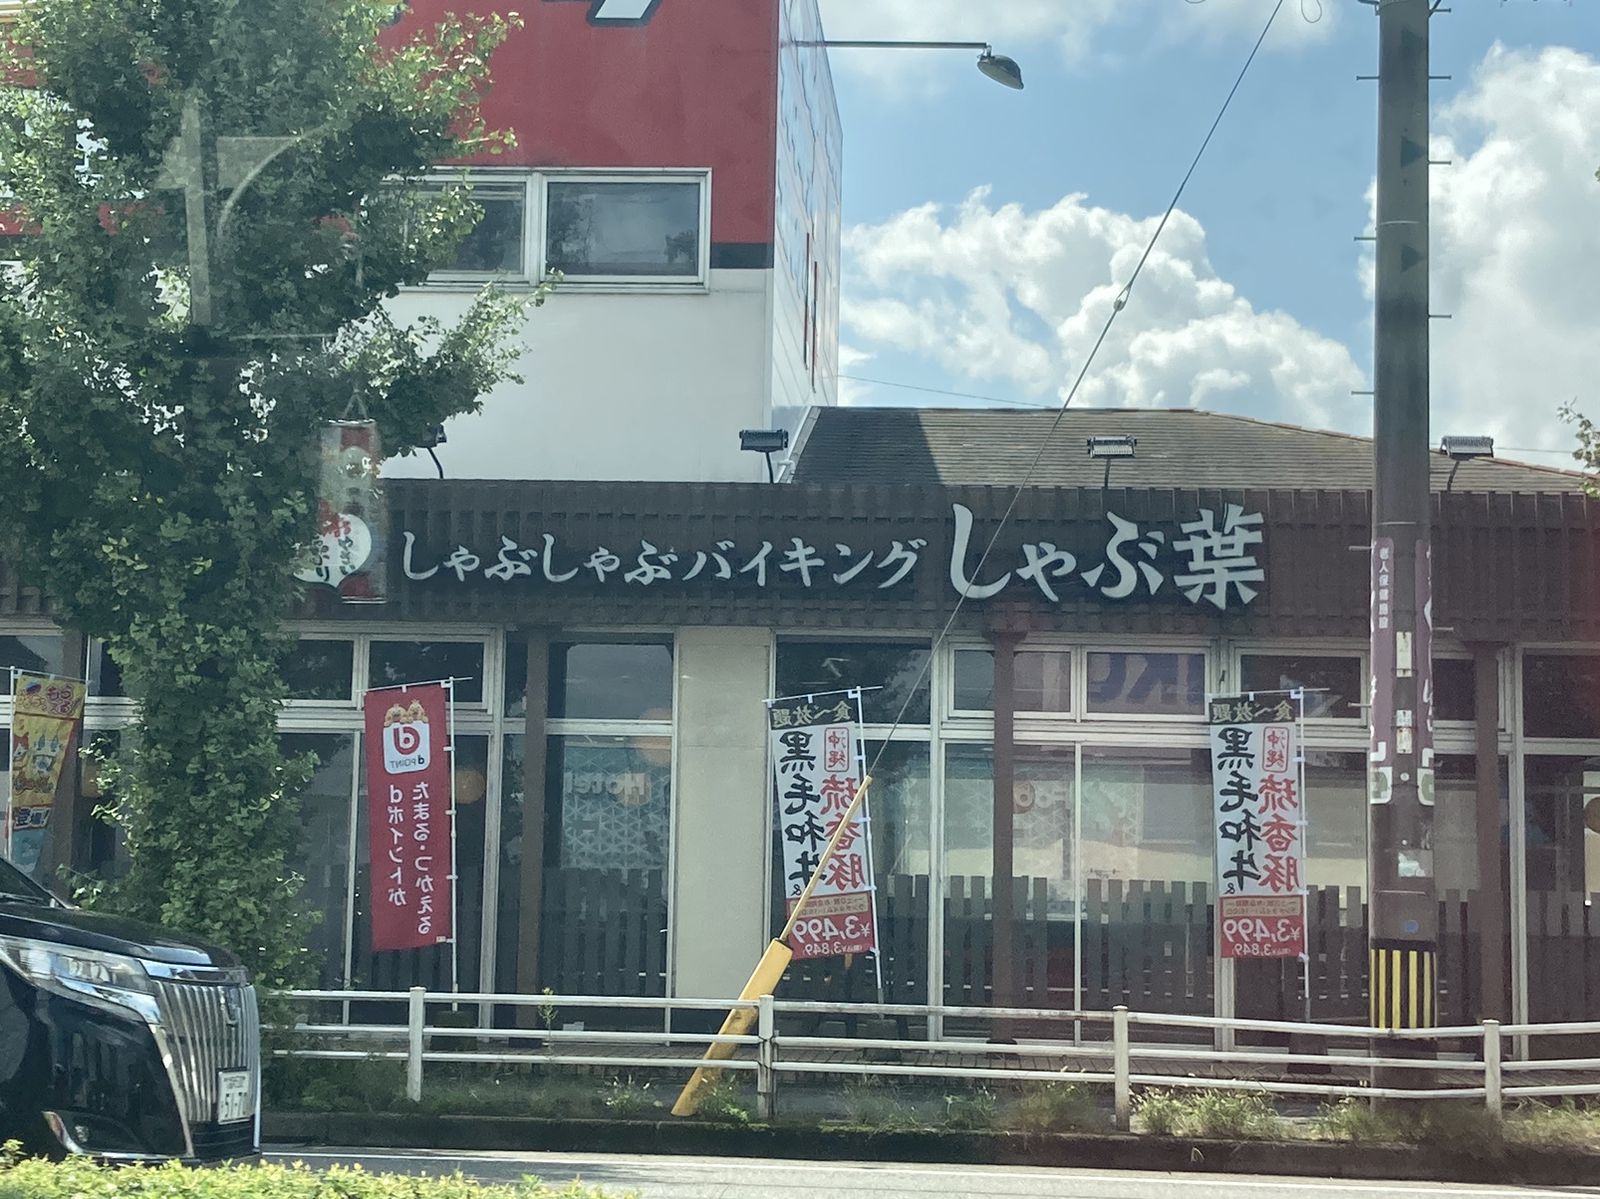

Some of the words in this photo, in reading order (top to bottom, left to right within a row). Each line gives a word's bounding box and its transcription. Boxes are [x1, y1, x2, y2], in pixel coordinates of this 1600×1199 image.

[402, 531, 928, 588] しゃぶしゃぶバイキング
[950, 503, 1265, 610] しゃぶ葉
